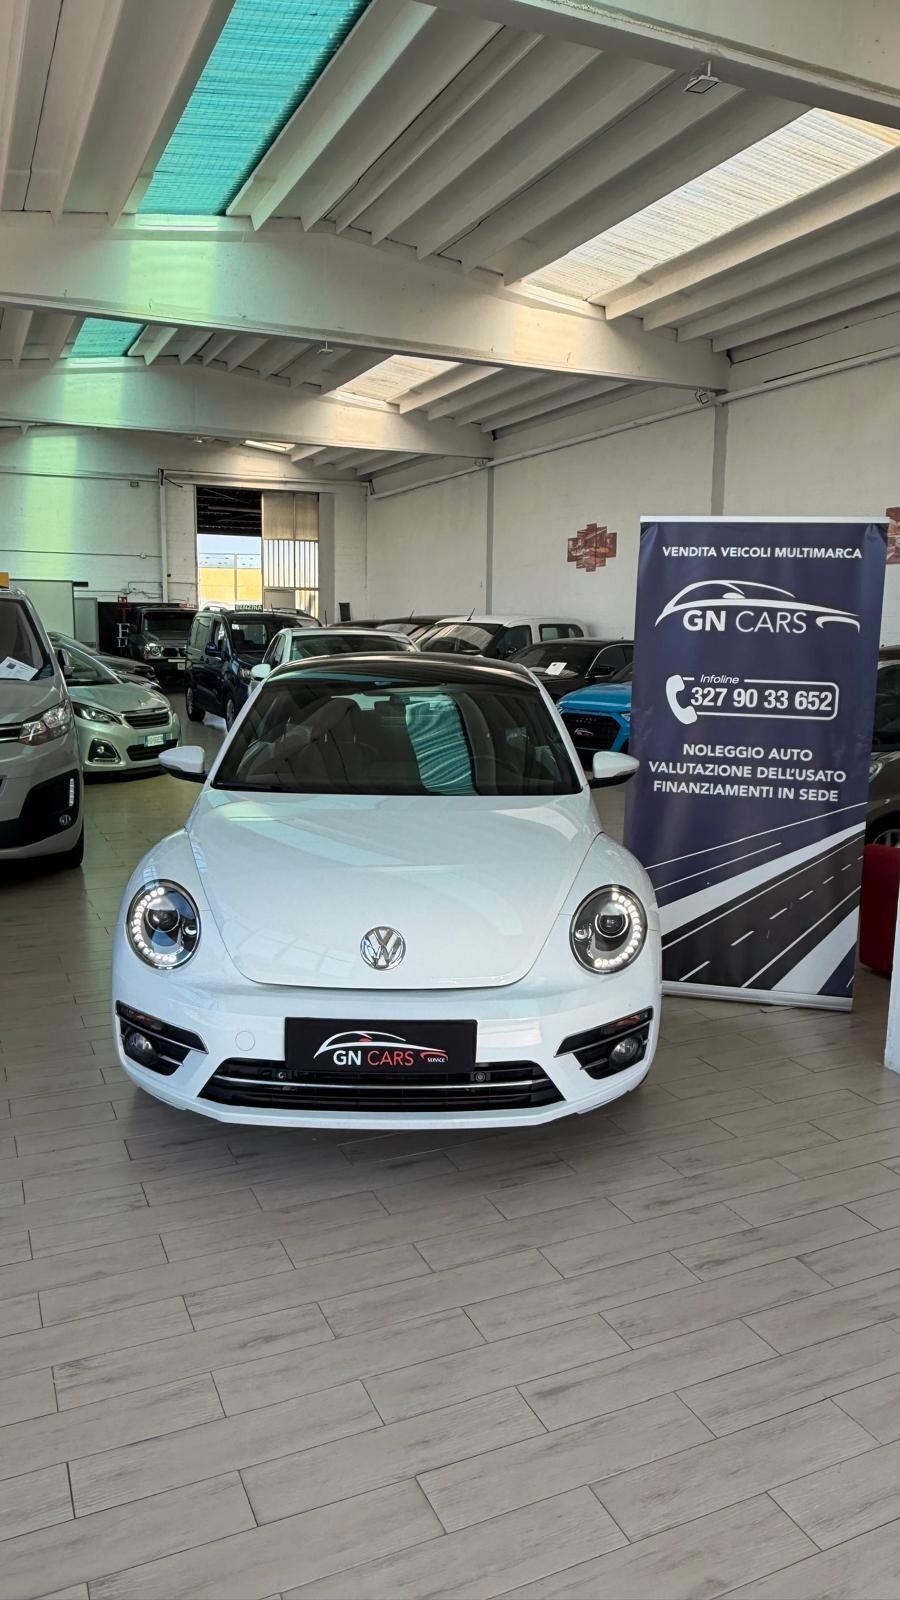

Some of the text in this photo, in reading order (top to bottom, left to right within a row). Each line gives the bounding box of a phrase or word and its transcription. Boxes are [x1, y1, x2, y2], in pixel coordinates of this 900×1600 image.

[662, 546, 862, 559] VENDITA VEICOLI MULTIMARCA
[682, 610, 807, 634] GN CARS
[700, 674, 740, 684] Infoline
[690, 686, 833, 711] 327 90 33 652
[682, 743, 813, 761] NOLEGGIO AUTO
[649, 761, 753, 778] VALUTAZIONE
[653, 780, 839, 802] FINANZIAMENTI IN SEDE
[333, 1050, 362, 1066] GN
[367, 1050, 414, 1066] CARS
